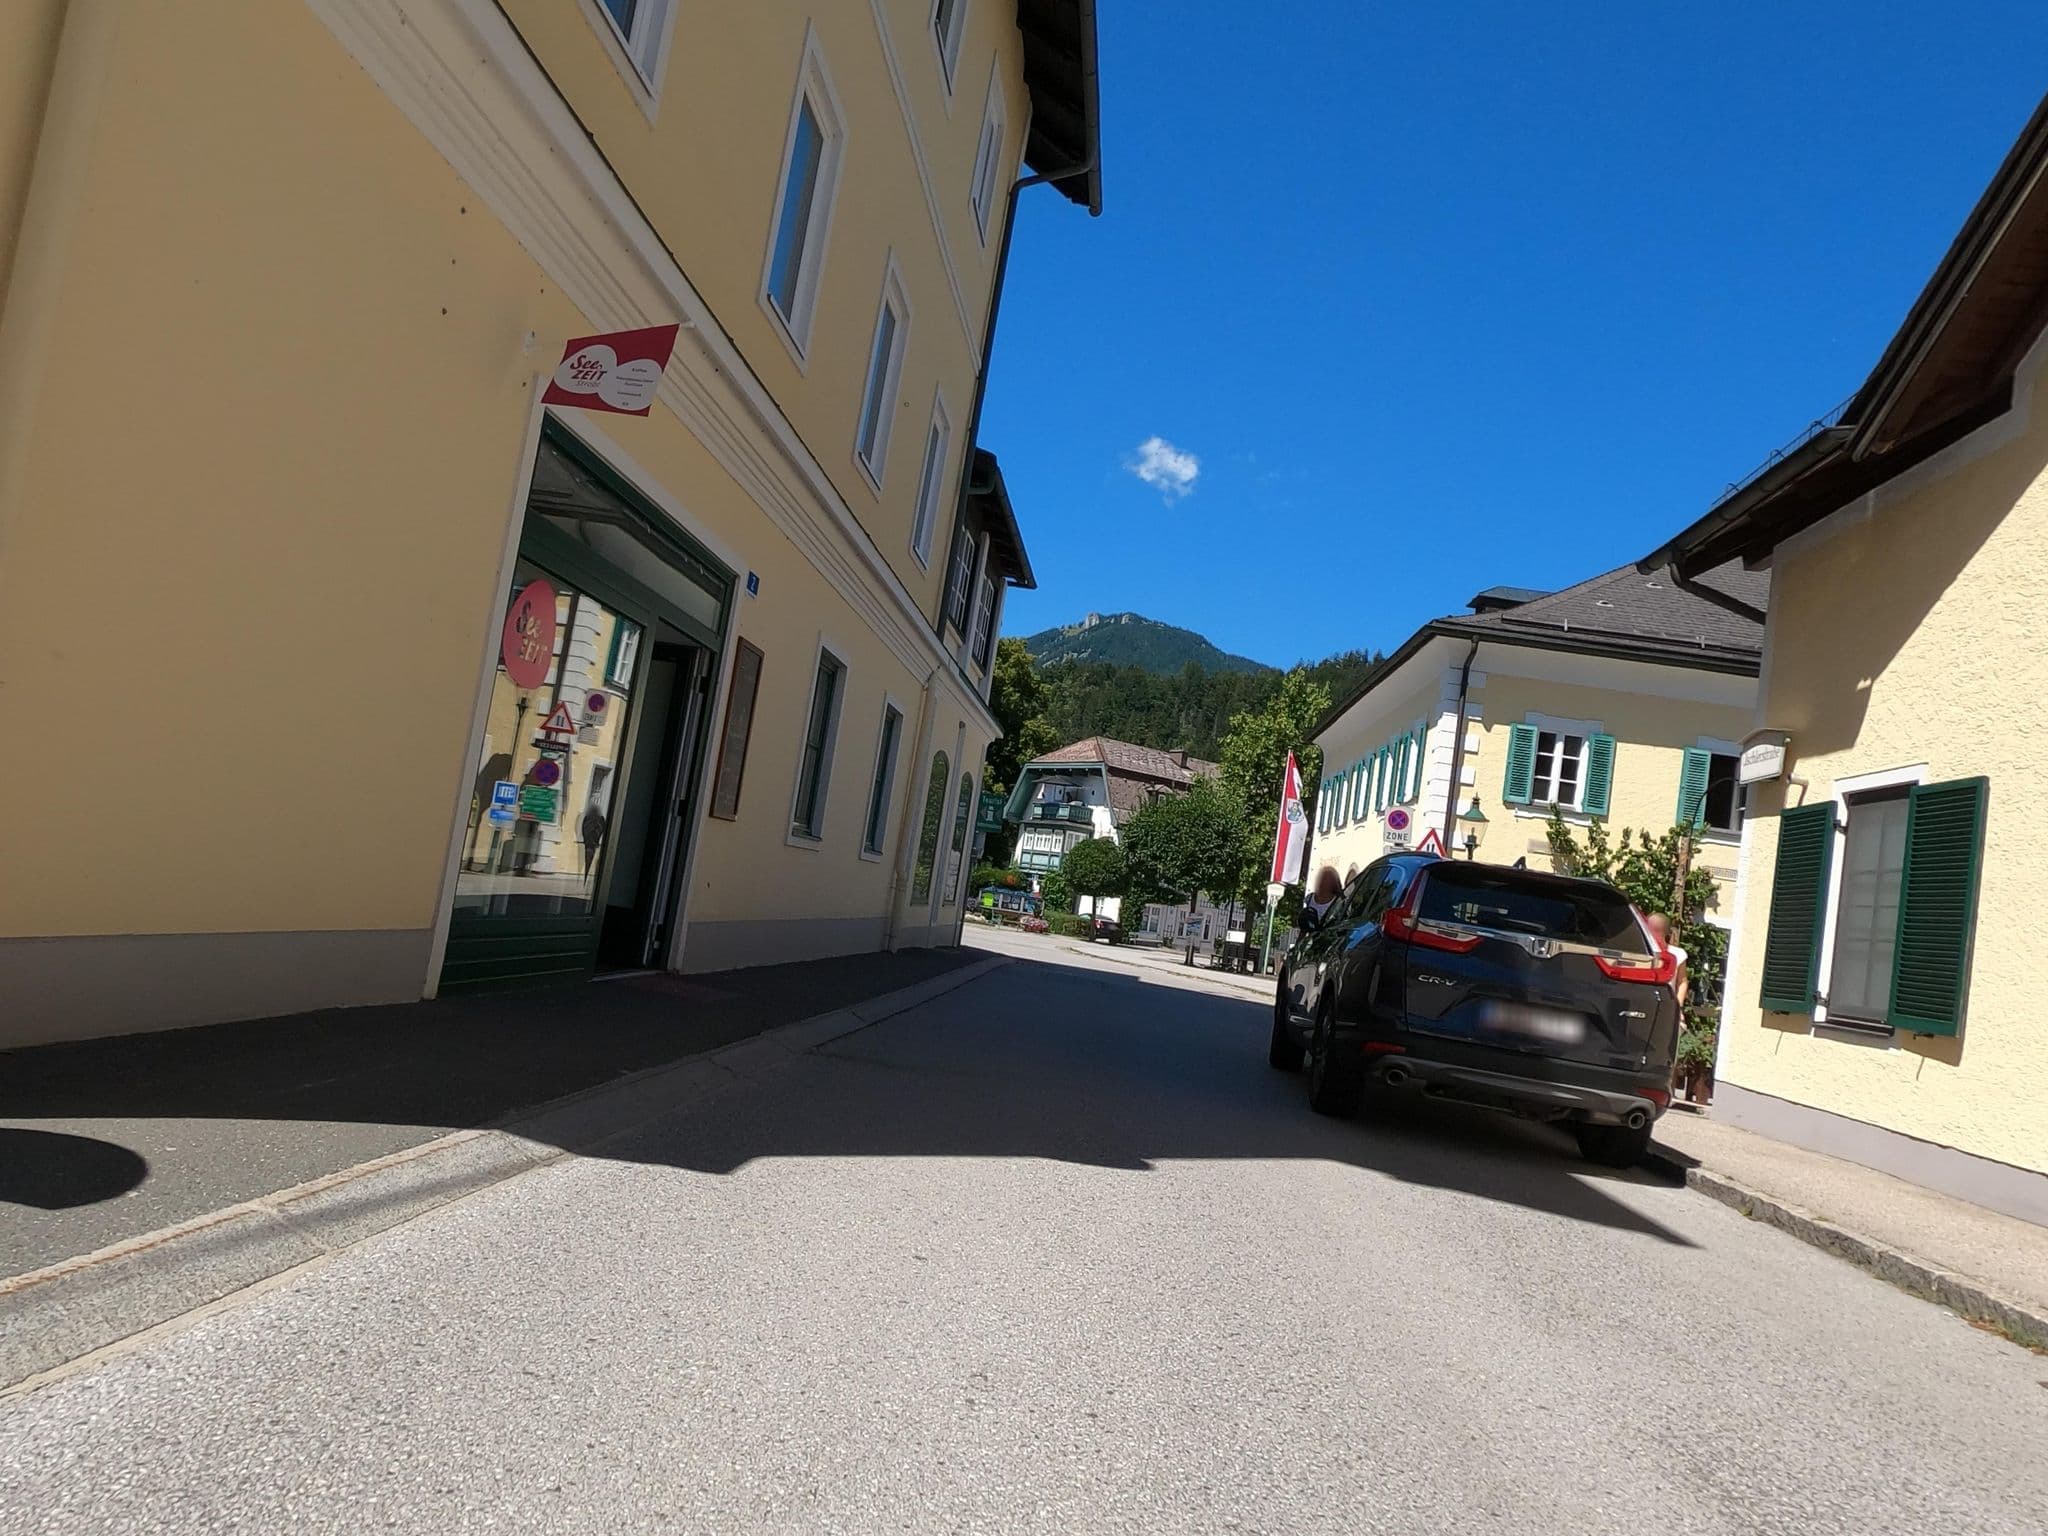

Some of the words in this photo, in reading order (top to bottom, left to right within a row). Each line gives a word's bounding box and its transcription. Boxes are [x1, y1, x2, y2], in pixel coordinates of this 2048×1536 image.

[570, 354, 601, 369] See
[571, 370, 607, 381] ZEIT
[1386, 831, 1409, 841] ZONE
[1417, 974, 1457, 986] CR-V
